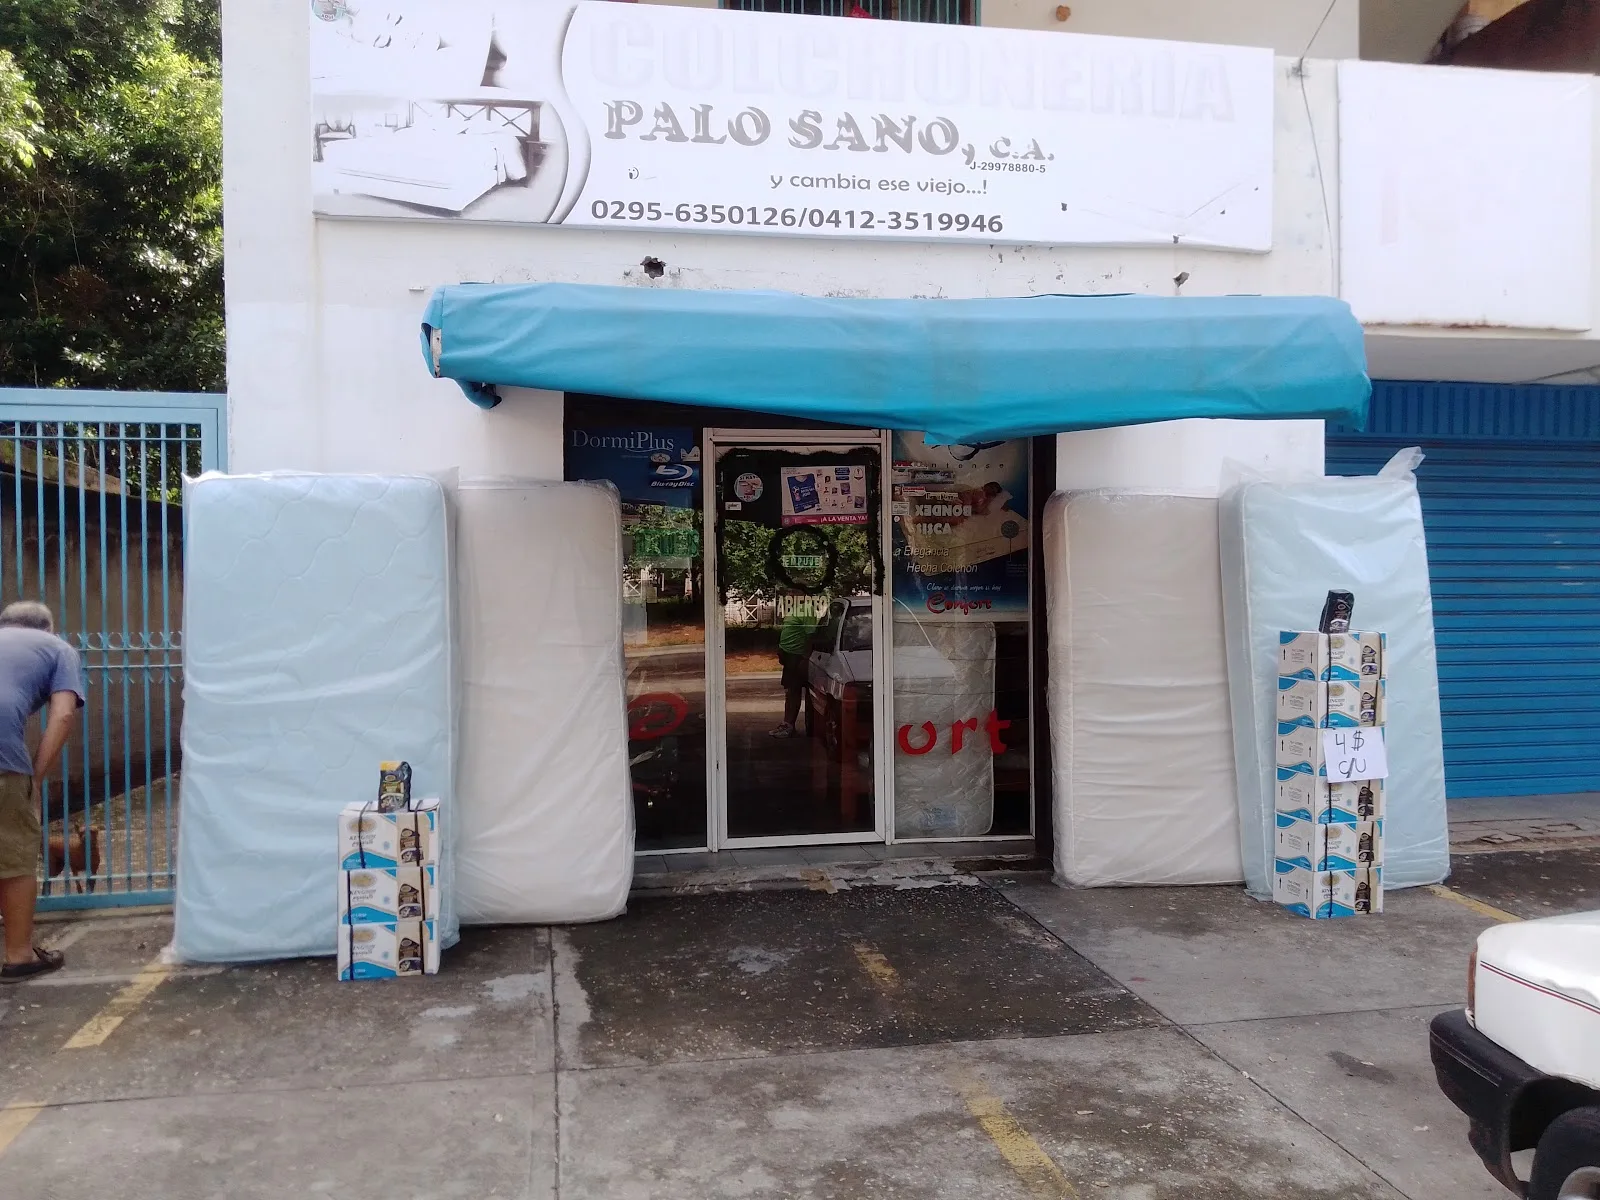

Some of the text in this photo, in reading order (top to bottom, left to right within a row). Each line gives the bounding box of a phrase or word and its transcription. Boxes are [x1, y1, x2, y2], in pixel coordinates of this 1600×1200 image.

[603, 100, 1055, 166] PALO SANO, C.A.
[970, 161, 1046, 174] J-29978880-5
[770, 174, 988, 196] y cambia ese viejo...!
[591, 200, 1003, 234] 0295-6350126/0412-3519946
[572, 429, 674, 450] DormiPlus
[906, 562, 938, 573] Hecha
[777, 595, 828, 618] ABIERTO
